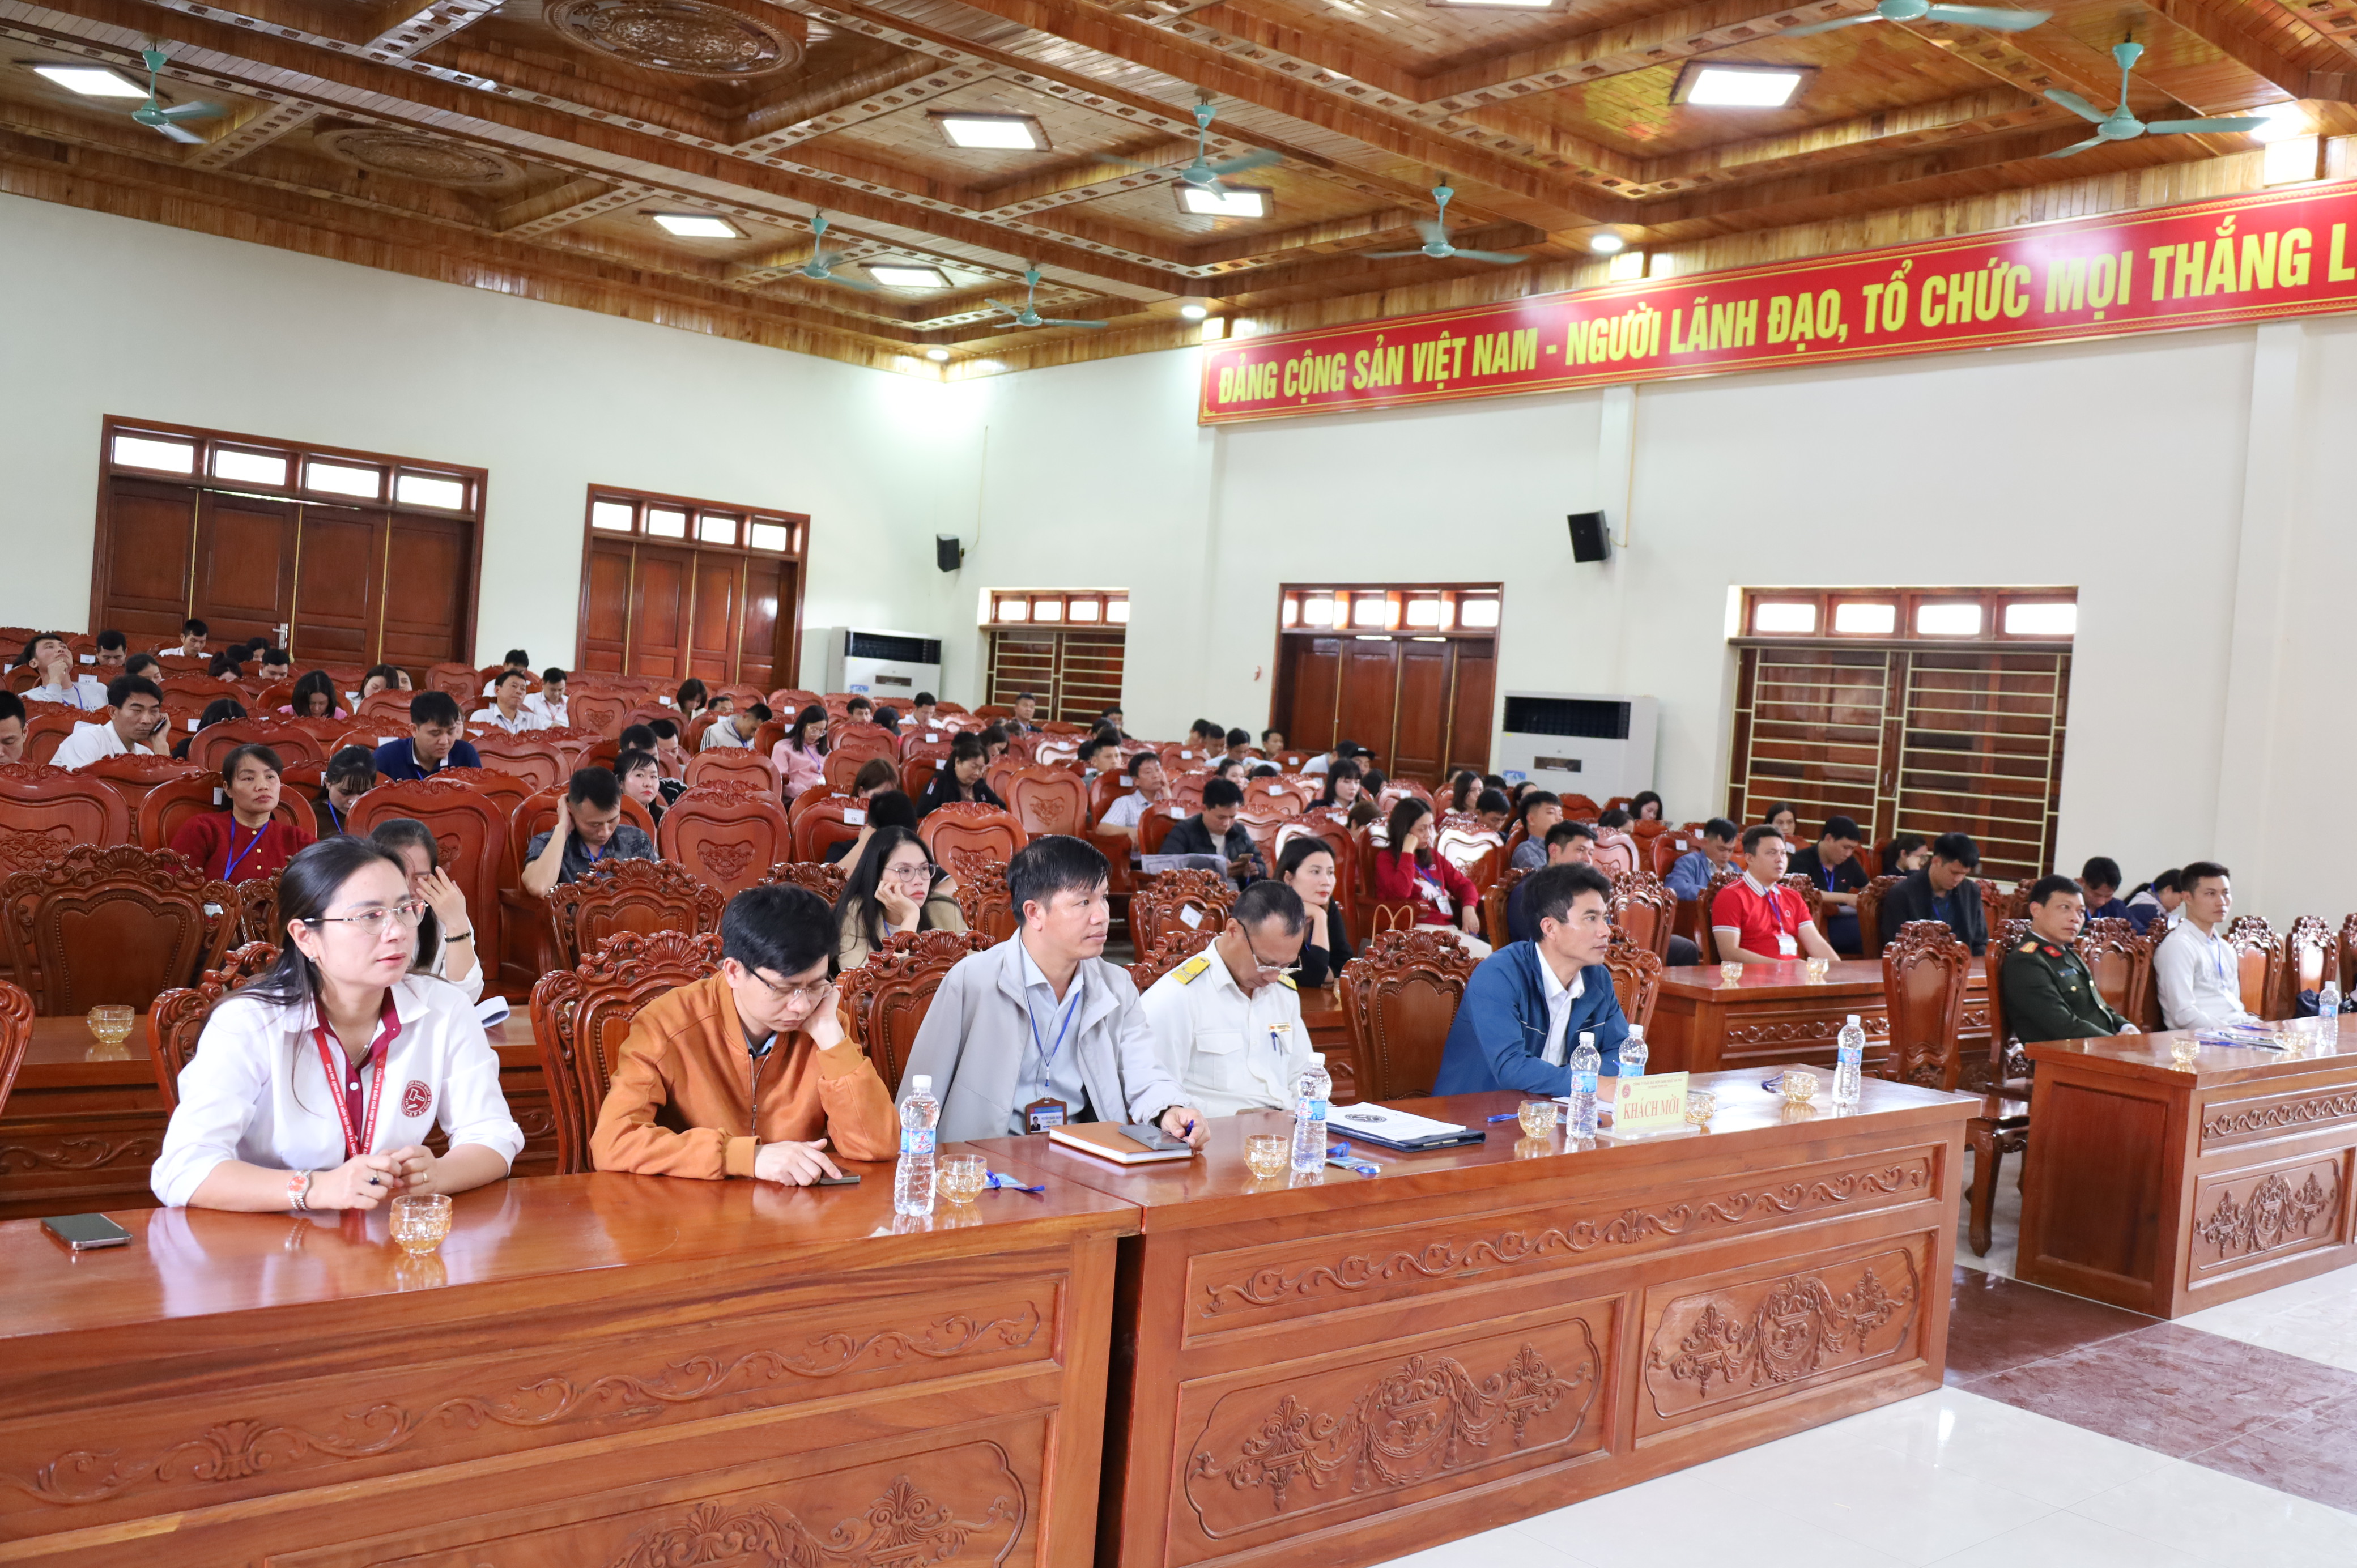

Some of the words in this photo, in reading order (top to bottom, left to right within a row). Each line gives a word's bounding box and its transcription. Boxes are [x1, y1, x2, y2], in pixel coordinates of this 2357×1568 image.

[1218, 352, 1278, 404] ĐẢNG
[1283, 348, 1347, 404] CỘNG
[1352, 334, 1405, 389] SẢN
[1412, 331, 1467, 390] VIỆT
[1472, 327, 1538, 376] NAM
[1565, 300, 1662, 366] NGƯỜI
[1670, 296, 1758, 354] LÃNH
[1767, 288, 1848, 351] ĐẠO,
[1862, 259, 1913, 333] TỔ
[1920, 257, 2030, 327] CHỨC
[2044, 251, 2133, 320] MỌI
[2148, 215, 2312, 301] THẮNG
[1623, 1097, 1659, 1119] KHÁCH
[1660, 1094, 1680, 1115] MỜI
